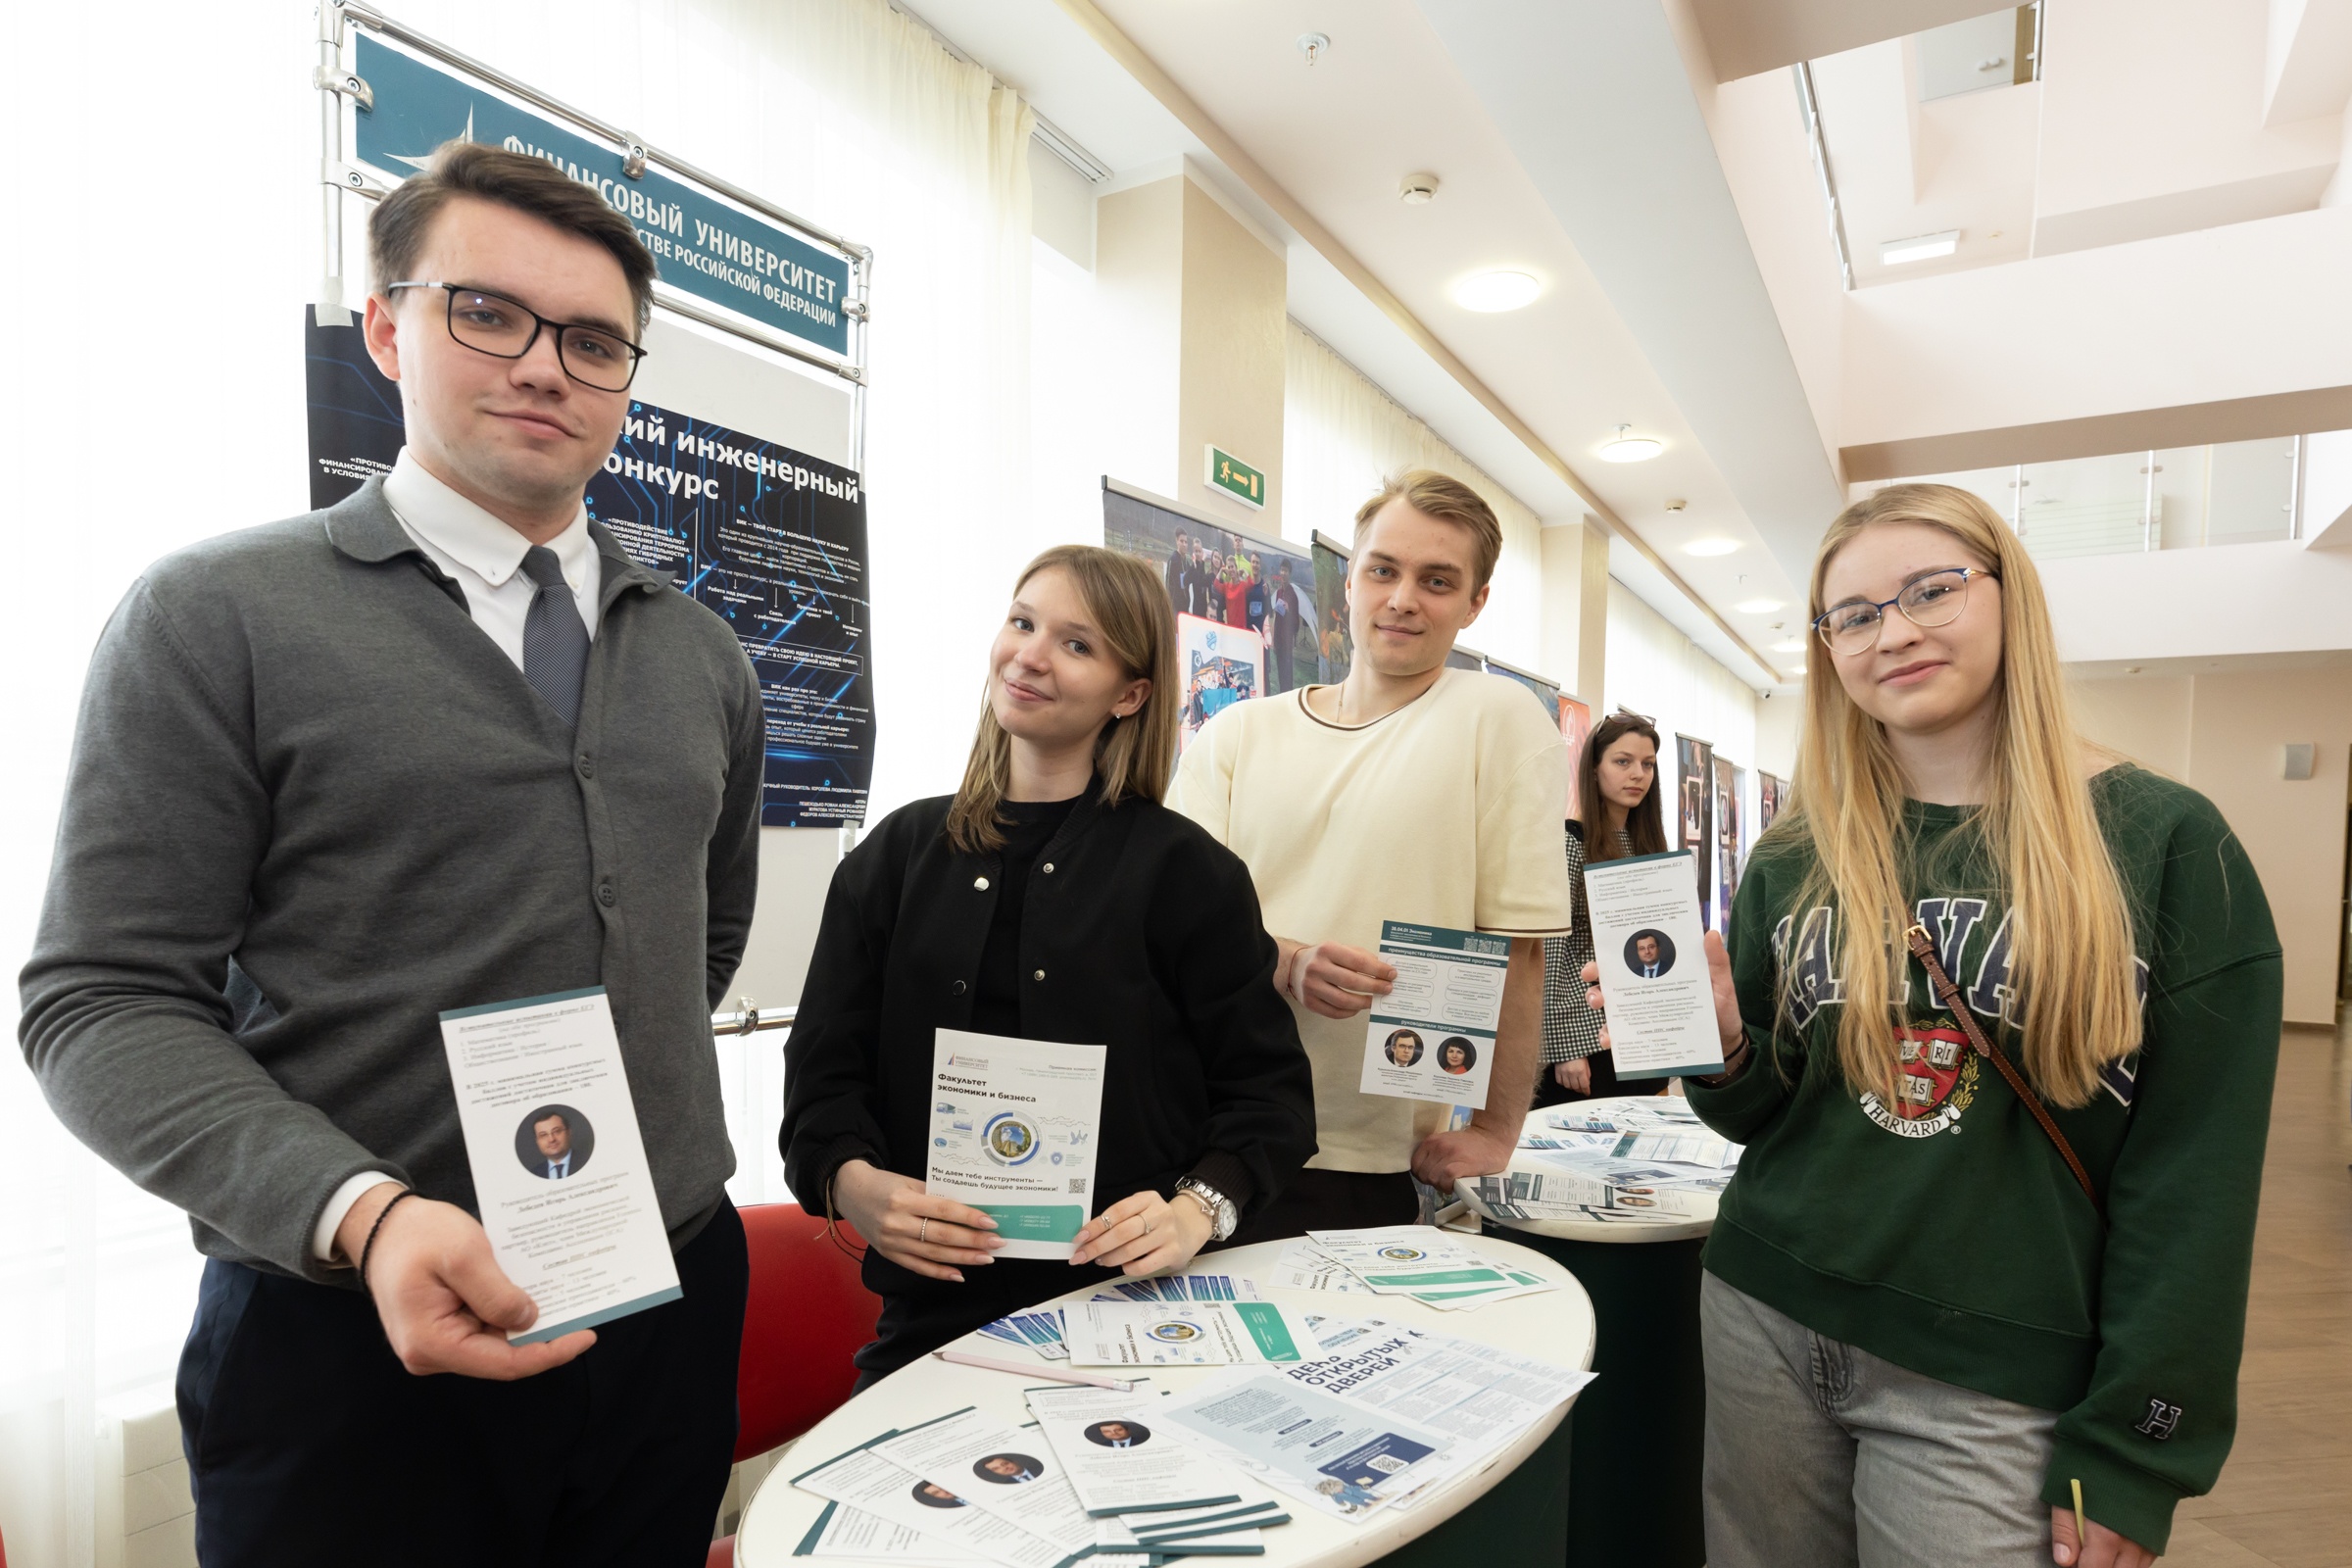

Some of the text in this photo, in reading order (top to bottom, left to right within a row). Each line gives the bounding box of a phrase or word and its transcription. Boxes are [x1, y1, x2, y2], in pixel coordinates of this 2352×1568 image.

[695, 219, 837, 303] УНИВЕРСИТЕТ
[636, 228, 836, 327] СТВЕ РОССИЙСКОЙ ФЕДЕРАЦИИ
[620, 415, 858, 503] ий инженерный
[332, 467, 370, 481] УСЛОВИЯ
[602, 453, 718, 500] онкурс
[601, 522, 685, 546] ОЛЬЗОВАНИЮ КРИПТОВАЛЮТ
[608, 517, 667, 535] «ПРОТИВОДЕЙСТВИЕ
[753, 521, 766, 531] ТВОЙ
[611, 531, 690, 553] АНСИРОВАНИЯ ТЕРРОРИЗМА
[617, 539, 684, 558] ОННОЙ ДЕЯТЕЛЬНОСТИ
[628, 554, 659, 564] ФЛИКТОВ»
[639, 549, 673, 562] ГИБРИДНЫХ
[1426, 953, 1471, 963] образовательной
[1471, 958, 1501, 967] программы
[1934, 1046, 1952, 1060] RI
[938, 1073, 987, 1088] Факультет
[937, 1084, 987, 1098] экономики
[998, 1091, 1037, 1102] бизнеса
[1869, 1105, 1941, 1136] HARVARD
[932, 1166, 944, 1175] Мы
[965, 1170, 983, 1180] тебе
[984, 1175, 1035, 1185] инструменты
[932, 1175, 941, 1184] Ты
[942, 1179, 979, 1189] создаешь
[980, 1182, 1013, 1192] будущее
[1305, 1338, 1409, 1386] ОТКРЫТЫХ
[2134, 1398, 2182, 1440] H
